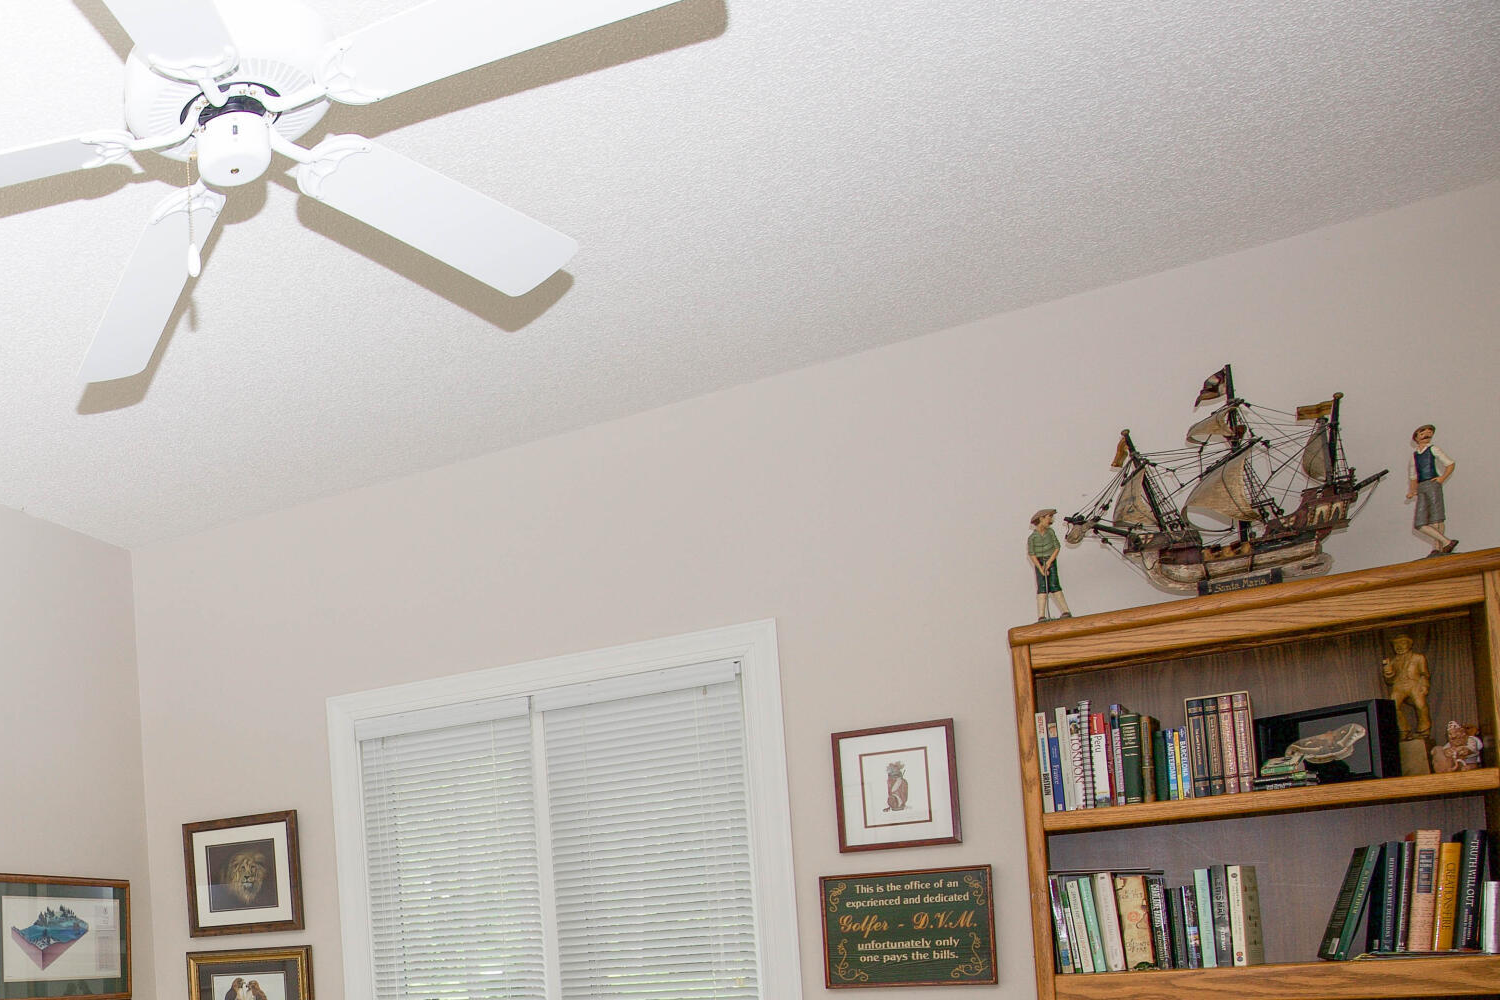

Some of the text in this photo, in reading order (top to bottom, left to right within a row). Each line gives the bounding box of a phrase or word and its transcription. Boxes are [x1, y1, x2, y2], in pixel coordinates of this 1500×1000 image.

[1094, 735, 1103, 753] Peru
[1070, 737, 1085, 784] LONDON
[1167, 742, 1177, 781] AMSTERDAM
[1179, 740, 1189, 777] BARCELONA
[1042, 772, 1051, 796] BRITAIN
[1052, 764, 1060, 785] France
[1469, 840, 1480, 869] TRUTH
[854, 879, 959, 895] This is the office of an
[1466, 869, 1476, 889] WILL
[845, 892, 970, 909] experienced and dedicated
[1465, 889, 1475, 907] OUT
[838, 914, 889, 938] Golfer
[911, 910, 978, 931] D.V.M.
[857, 936, 960, 951] unfortunately only
[859, 949, 959, 965] one pays the bills.
